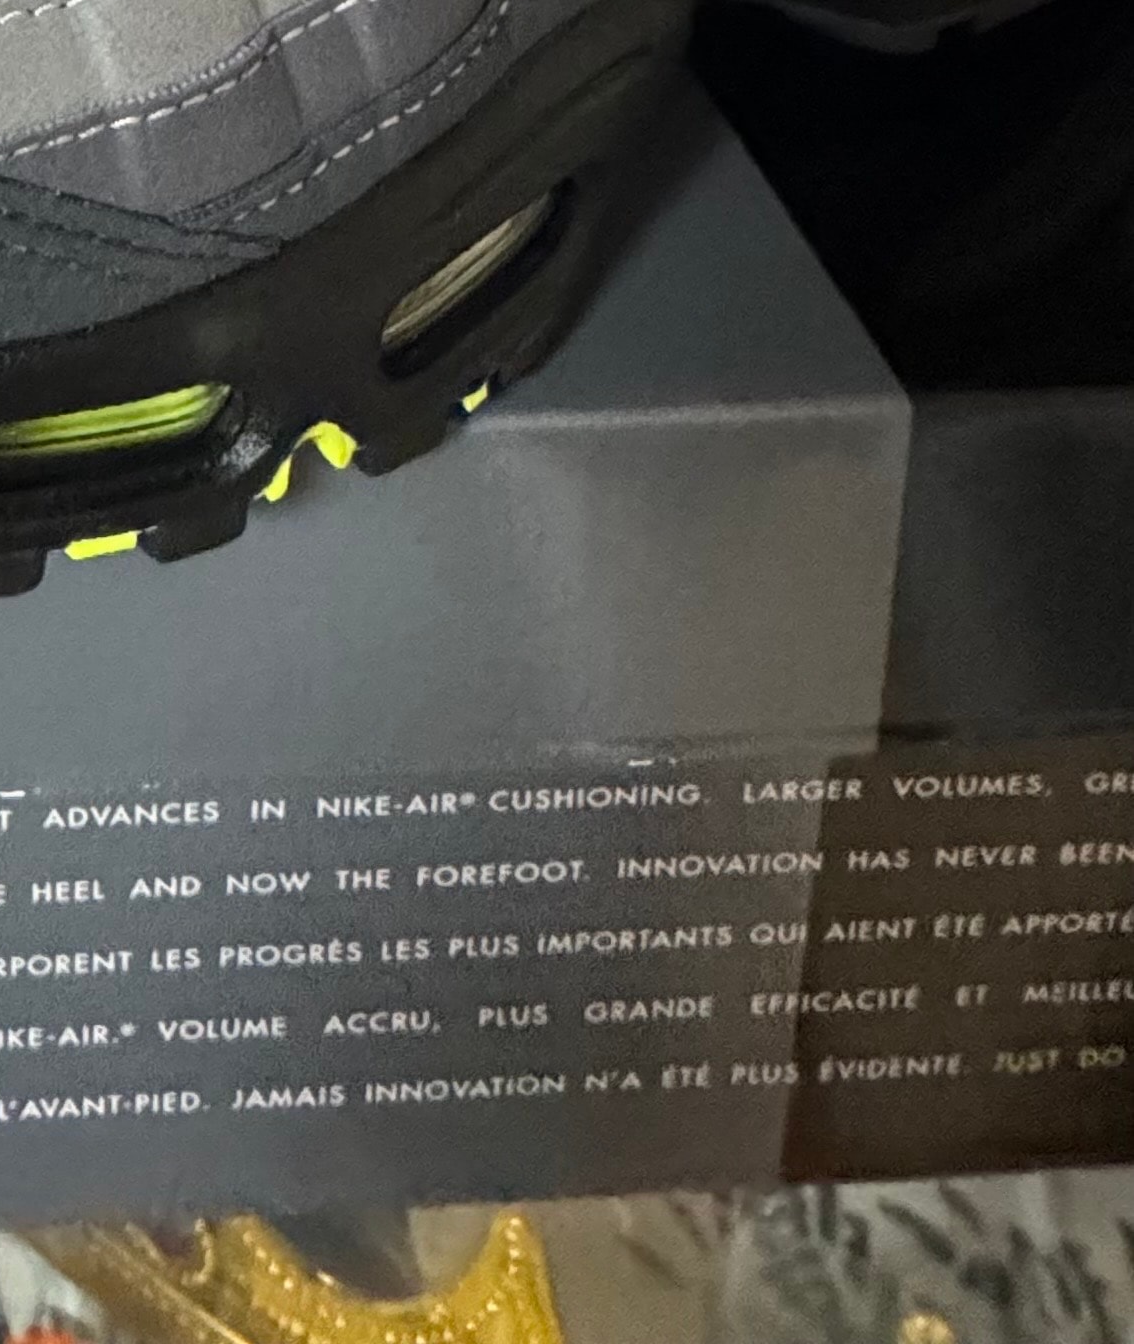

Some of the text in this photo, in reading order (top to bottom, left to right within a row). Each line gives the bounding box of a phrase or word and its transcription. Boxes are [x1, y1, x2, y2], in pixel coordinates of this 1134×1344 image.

[42, 800, 221, 830] ADVANCES
[250, 798, 287, 823] IN
[742, 777, 863, 805] LARGER
[891, 773, 1053, 801] VOLUMES,
[31, 878, 106, 905] HEEL
[128, 874, 203, 901] AND
[225, 870, 312, 897] NOW
[334, 867, 391, 892] THE
[616, 851, 824, 880] INNOVATION
[846, 848, 911, 872] HAS
[934, 843, 1037, 869] NEVER
[1058, 841, 1134, 867] BEEN
[149, 947, 202, 973] LES
[380, 938, 431, 964] LES
[447, 933, 520, 960] PLUS
[536, 924, 734, 956] IMPORTANTS
[749, 920, 808, 952] QUI
[823, 916, 918, 943] AIENT
[156, 1015, 288, 1044] VOLUME
[478, 1002, 549, 1030] PLUS
[583, 995, 715, 1025] GRANDE
[954, 984, 989, 1008] ET
[231, 1083, 347, 1112] JAMAIS
[364, 1073, 567, 1105] INNOVATION
[583, 1070, 642, 1092] N'A
[730, 1061, 800, 1086] PLUS
